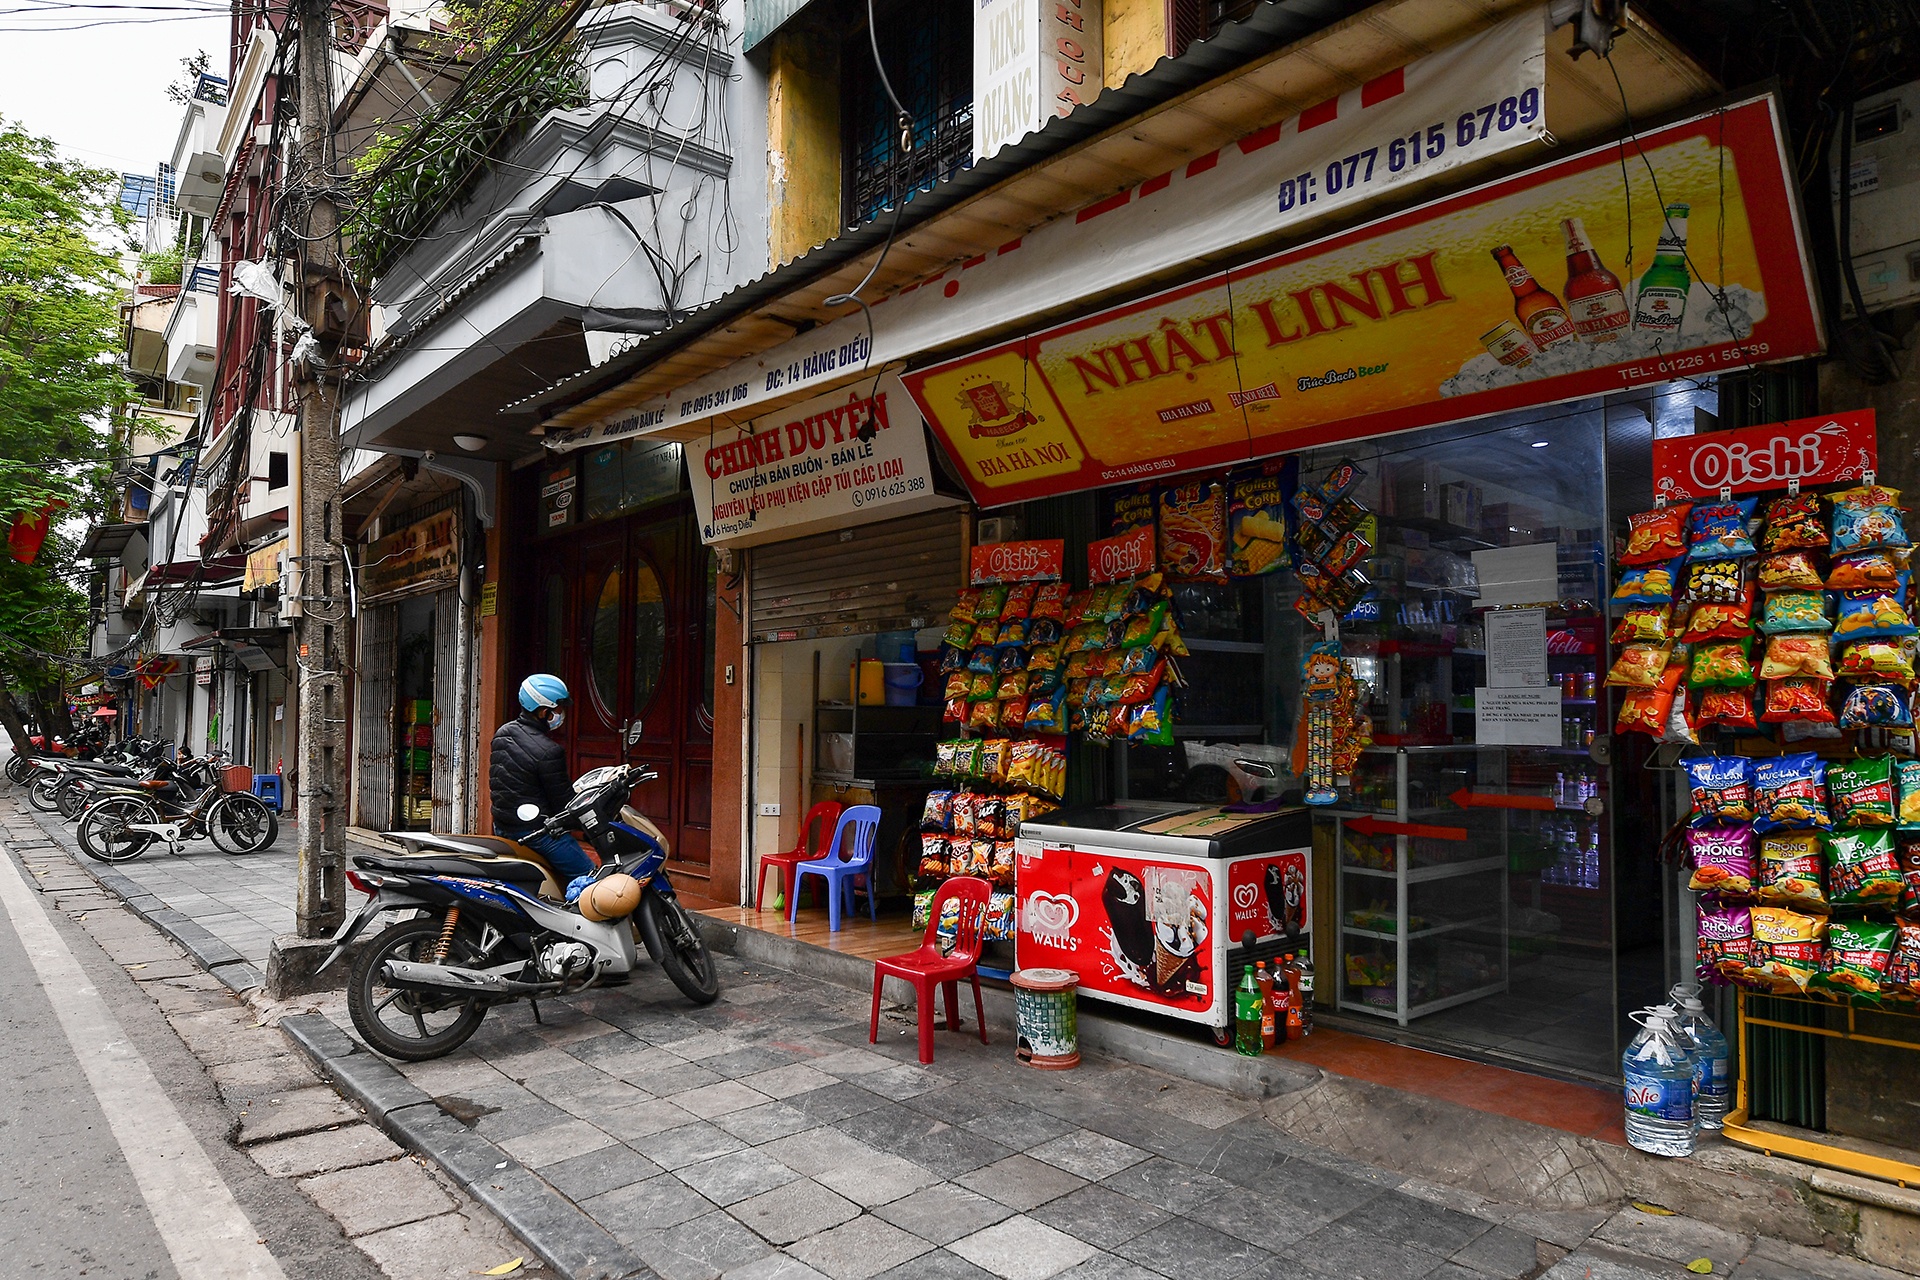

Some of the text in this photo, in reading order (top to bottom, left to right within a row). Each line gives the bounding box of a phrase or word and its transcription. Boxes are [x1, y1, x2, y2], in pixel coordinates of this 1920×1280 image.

[988, 0, 1025, 76] MINH
[981, 67, 1033, 160] QUANG
[1278, 87, 1538, 213] ĐT: 077 615 6789
[1066, 251, 1453, 396] NHẬT LINH
[680, 400, 691, 417] ĐT:
[693, 394, 713, 413] 0915
[715, 389, 731, 407] 341
[732, 383, 748, 401] 066
[766, 371, 784, 391] ĐC:
[787, 363, 799, 383] 14
[803, 349, 835, 380] HÀNG
[839, 333, 869, 367] ĐIẾU
[1298, 376, 1325, 391] Trúc
[1357, 363, 1389, 378] Beer
[1618, 367, 1654, 380] TEL:
[1658, 355, 1704, 373] 01226
[1708, 354, 1716, 363] 1
[1231, 384, 1278, 406] HANOI BEER
[986, 423, 1020, 436] HABECO
[1160, 410, 1178, 422] BIA
[704, 392, 890, 479] CHÍNH DUYÊN
[769, 464, 791, 485] BÁN
[792, 456, 823, 479] BUÔN
[831, 446, 856, 467] BÁN
[976, 442, 1072, 477] BIA HÀ NỘI
[1690, 433, 1824, 490] Oishi
[768, 491, 786, 508] PHỤ
[787, 481, 810, 504] KIỆN
[812, 474, 832, 498] CẶP
[834, 469, 851, 491] TÚI
[854, 463, 876, 487] CÁC
[878, 457, 904, 481] LOẠI
[865, 477, 925, 501] 0916 625 388
[1122, 507, 1153, 523] CORN
[1244, 490, 1281, 510] CORN
[990, 547, 1038, 572] Oishi
[1101, 539, 1142, 577] Oishi
[1234, 908, 1258, 921] WALL'S
[1031, 931, 1077, 951] WALL'S
